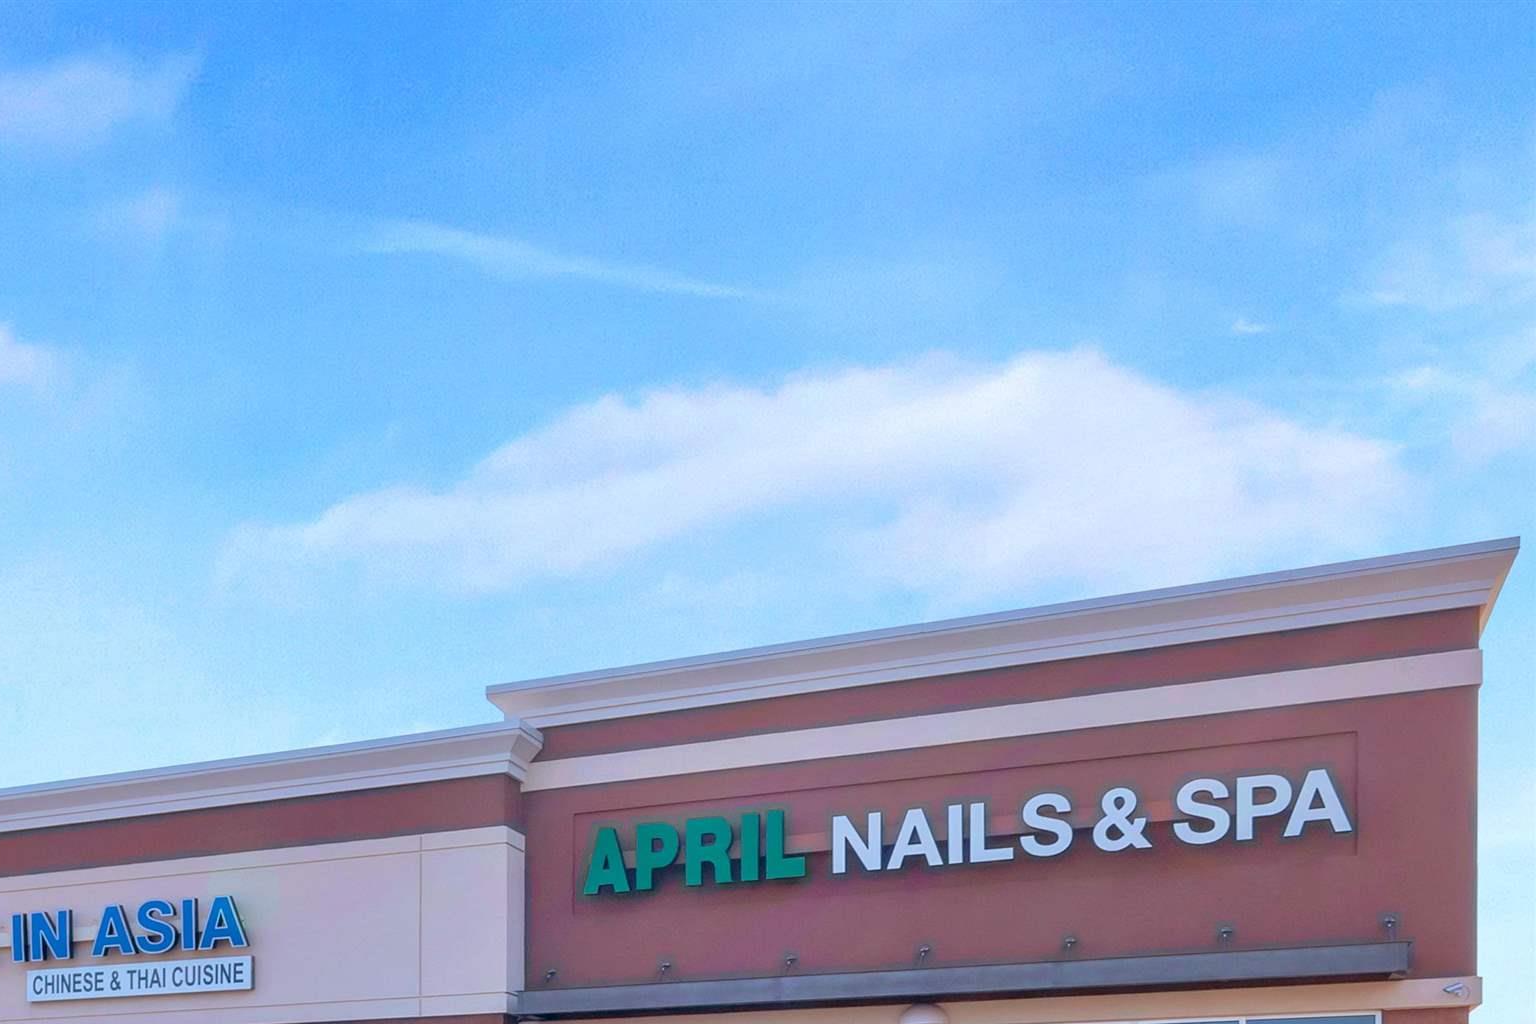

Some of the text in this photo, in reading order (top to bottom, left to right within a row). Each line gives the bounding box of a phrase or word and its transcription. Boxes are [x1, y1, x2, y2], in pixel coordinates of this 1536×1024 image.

[584, 768, 1352, 896] APRIL NAILS & SPA
[11, 908, 72, 963] IN
[91, 895, 248, 957] ASIA
[32, 962, 244, 996] CHINESE & THAI CUISINE
